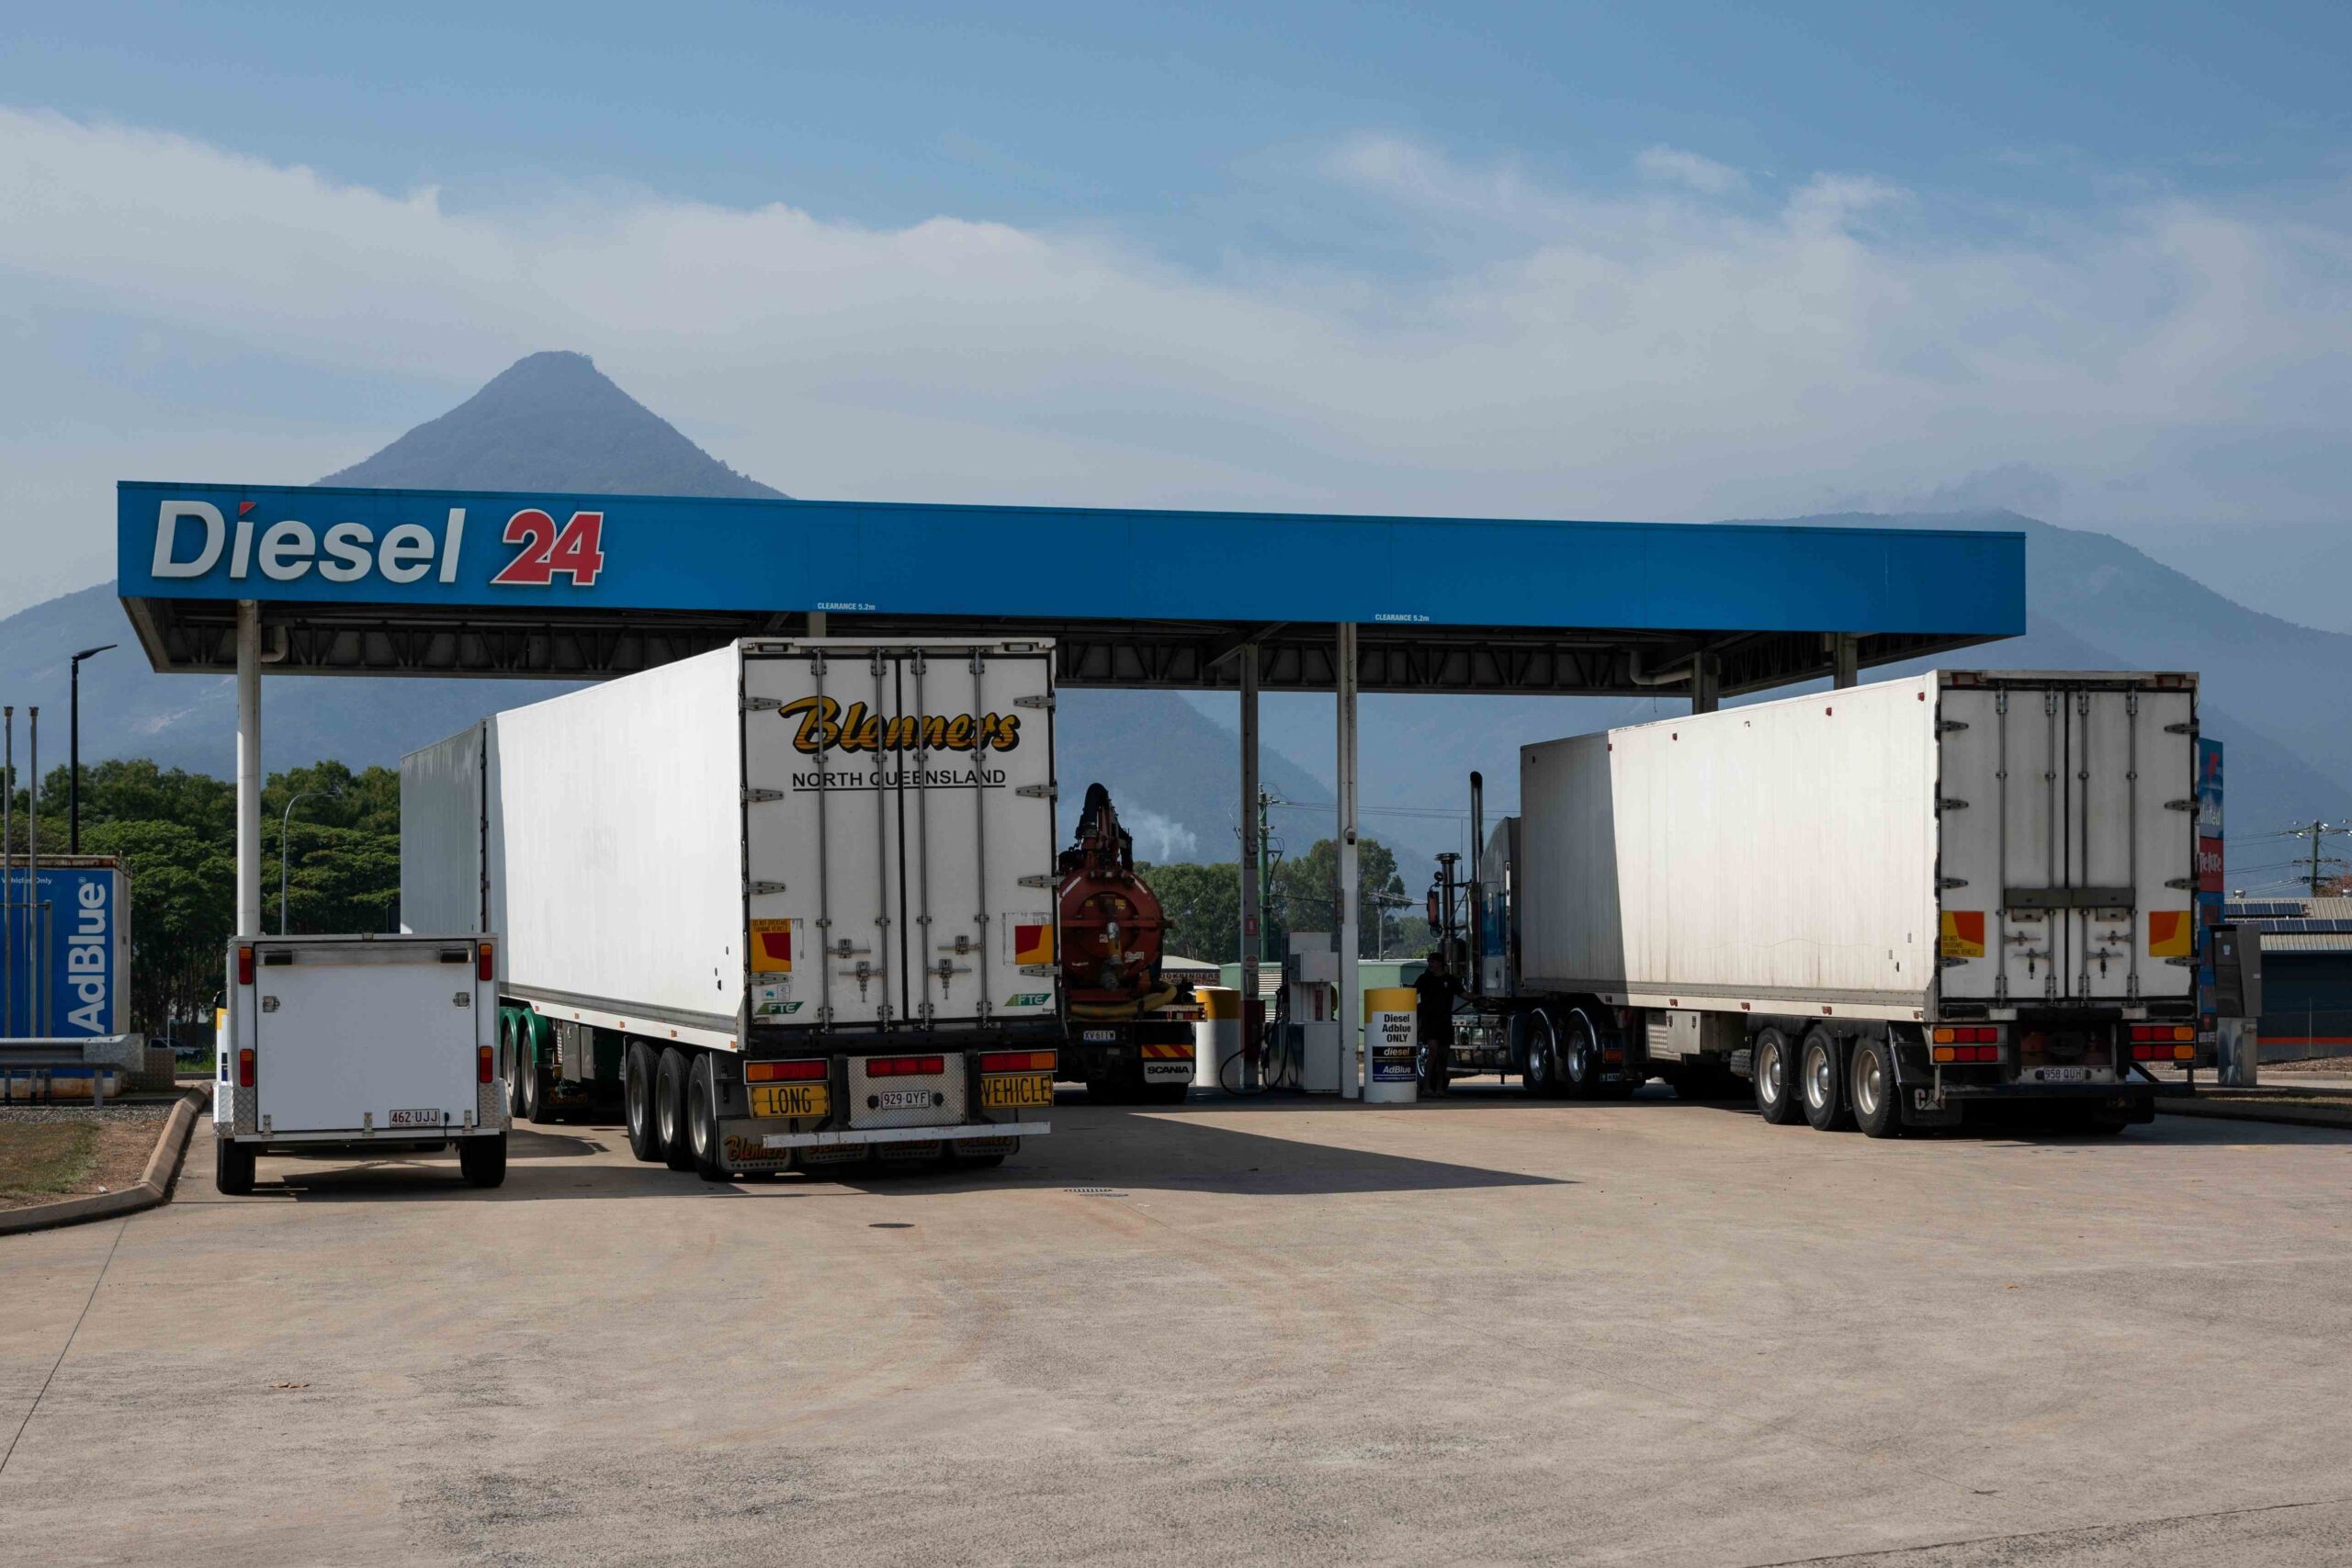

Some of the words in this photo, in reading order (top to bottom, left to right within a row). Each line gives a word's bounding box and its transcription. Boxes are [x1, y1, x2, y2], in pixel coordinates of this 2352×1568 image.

[152, 500, 467, 583] Diesel
[490, 508, 605, 586] 24
[817, 602, 857, 610] CLEARANCE
[858, 603, 876, 611] 5.2m
[778, 695, 1021, 754] Blenners
[792, 772, 863, 787] NORTH
[869, 770, 1006, 786] QUEENSLAND
[1019, 994, 1046, 1005] FTE
[768, 1003, 797, 1014] FTE
[1384, 1014, 1410, 1022] Diesel
[1382, 1024, 1411, 1032] Adblue
[1386, 1034, 1408, 1043] ONLY
[1383, 1047, 1410, 1056] diesel
[1148, 1066, 1190, 1074] SCANIA
[1382, 1066, 1412, 1074] AdBlue
[981, 1077, 1051, 1105] VEHICLE
[768, 1087, 812, 1114] LONG
